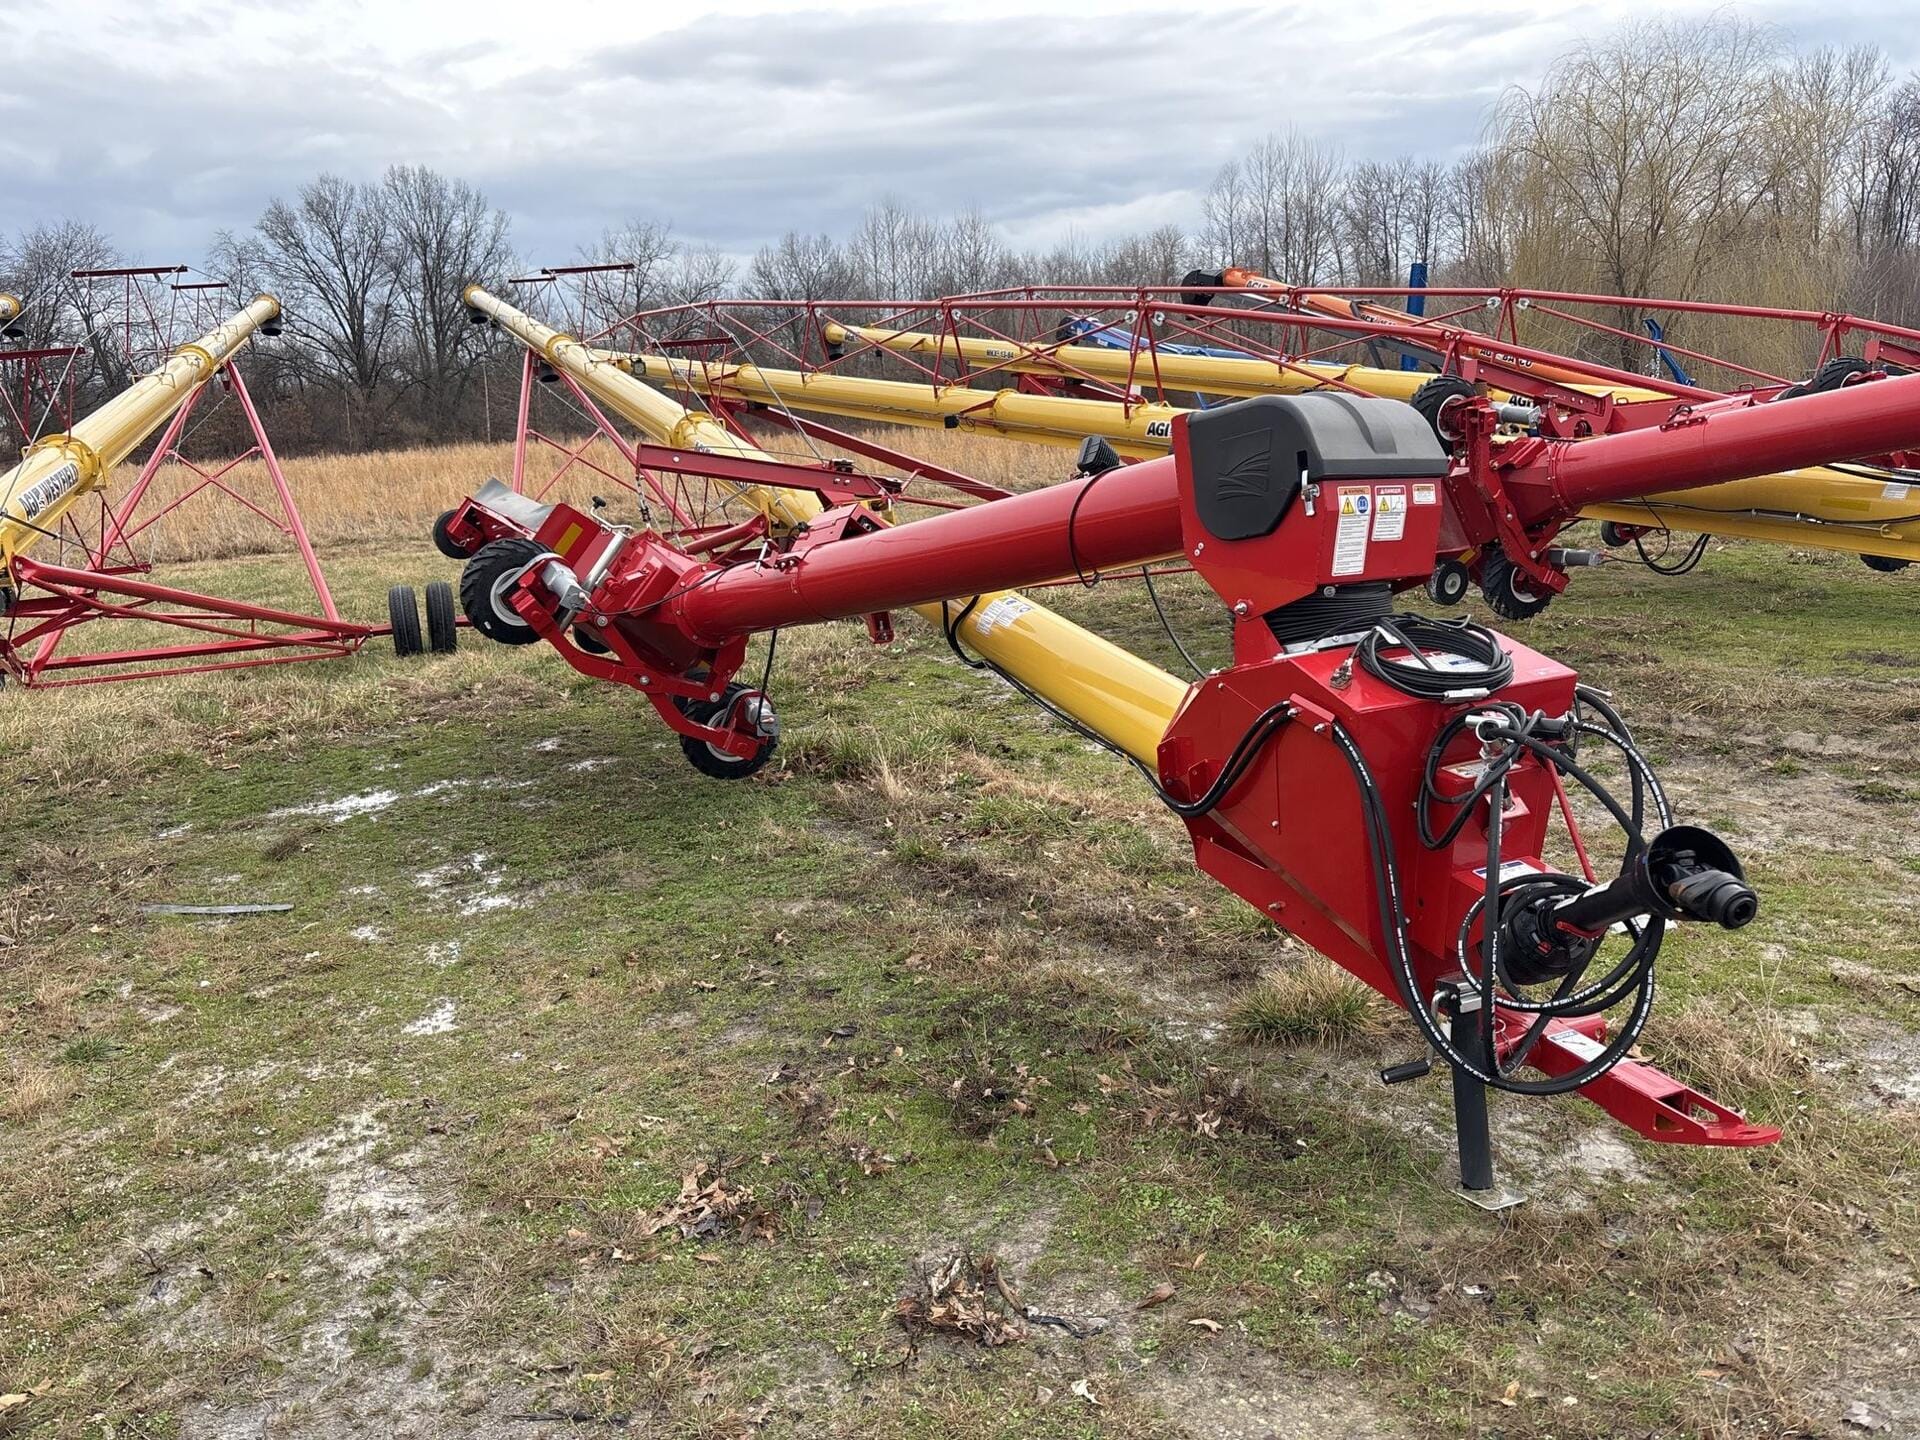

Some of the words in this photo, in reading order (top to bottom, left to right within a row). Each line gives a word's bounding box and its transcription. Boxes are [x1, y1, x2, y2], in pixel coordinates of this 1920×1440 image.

[1146, 421, 1170, 437] AGI
[18, 491, 39, 520] AGI
[38, 462, 79, 506] WESTFIELD
